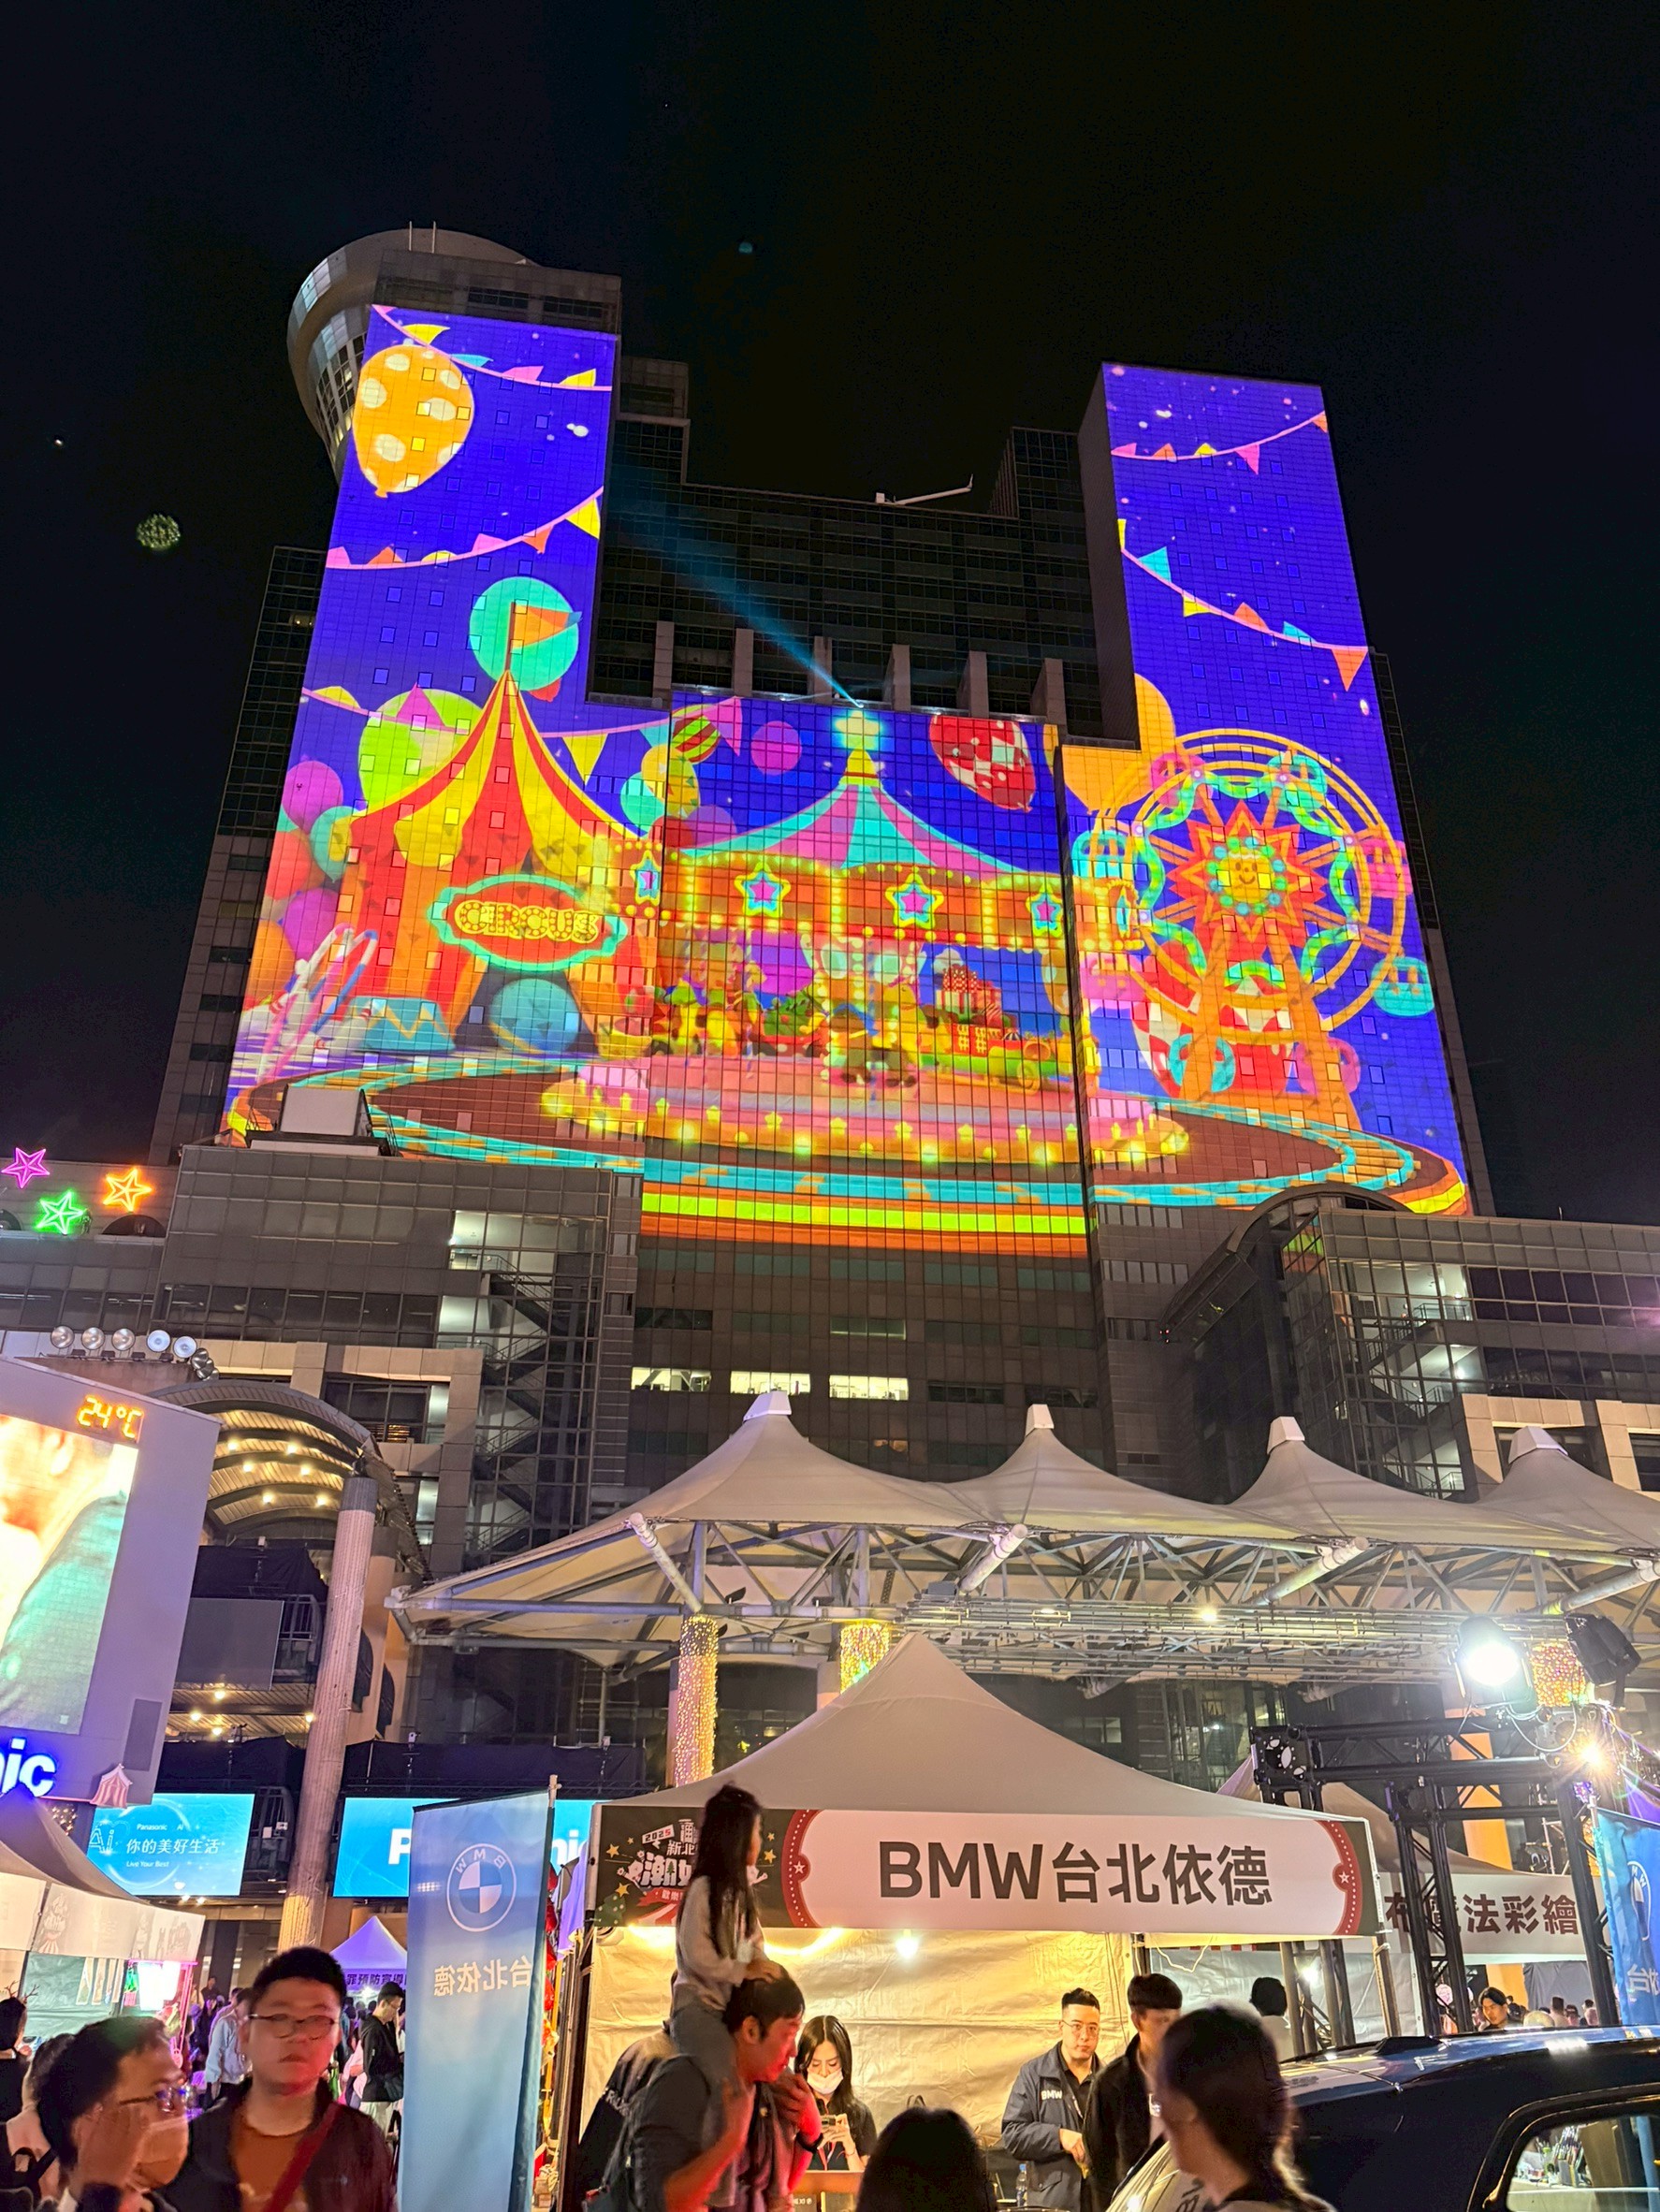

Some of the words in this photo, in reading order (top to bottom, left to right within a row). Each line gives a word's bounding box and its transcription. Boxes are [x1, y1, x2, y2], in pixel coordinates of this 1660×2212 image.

[455, 899, 599, 944] CIRCUS
[77, 1396, 143, 1439] 24°C
[137, 1823, 168, 1831] Panasonic
[644, 1827, 672, 1843] 2025
[126, 1838, 220, 1855] 你的美好生活
[665, 1840, 698, 1855] 新北
[880, 1841, 1273, 1906] BMW台北依德
[346, 1973, 406, 1986] 罪預防宣導
[1041, 2089, 1063, 2101] BMW
